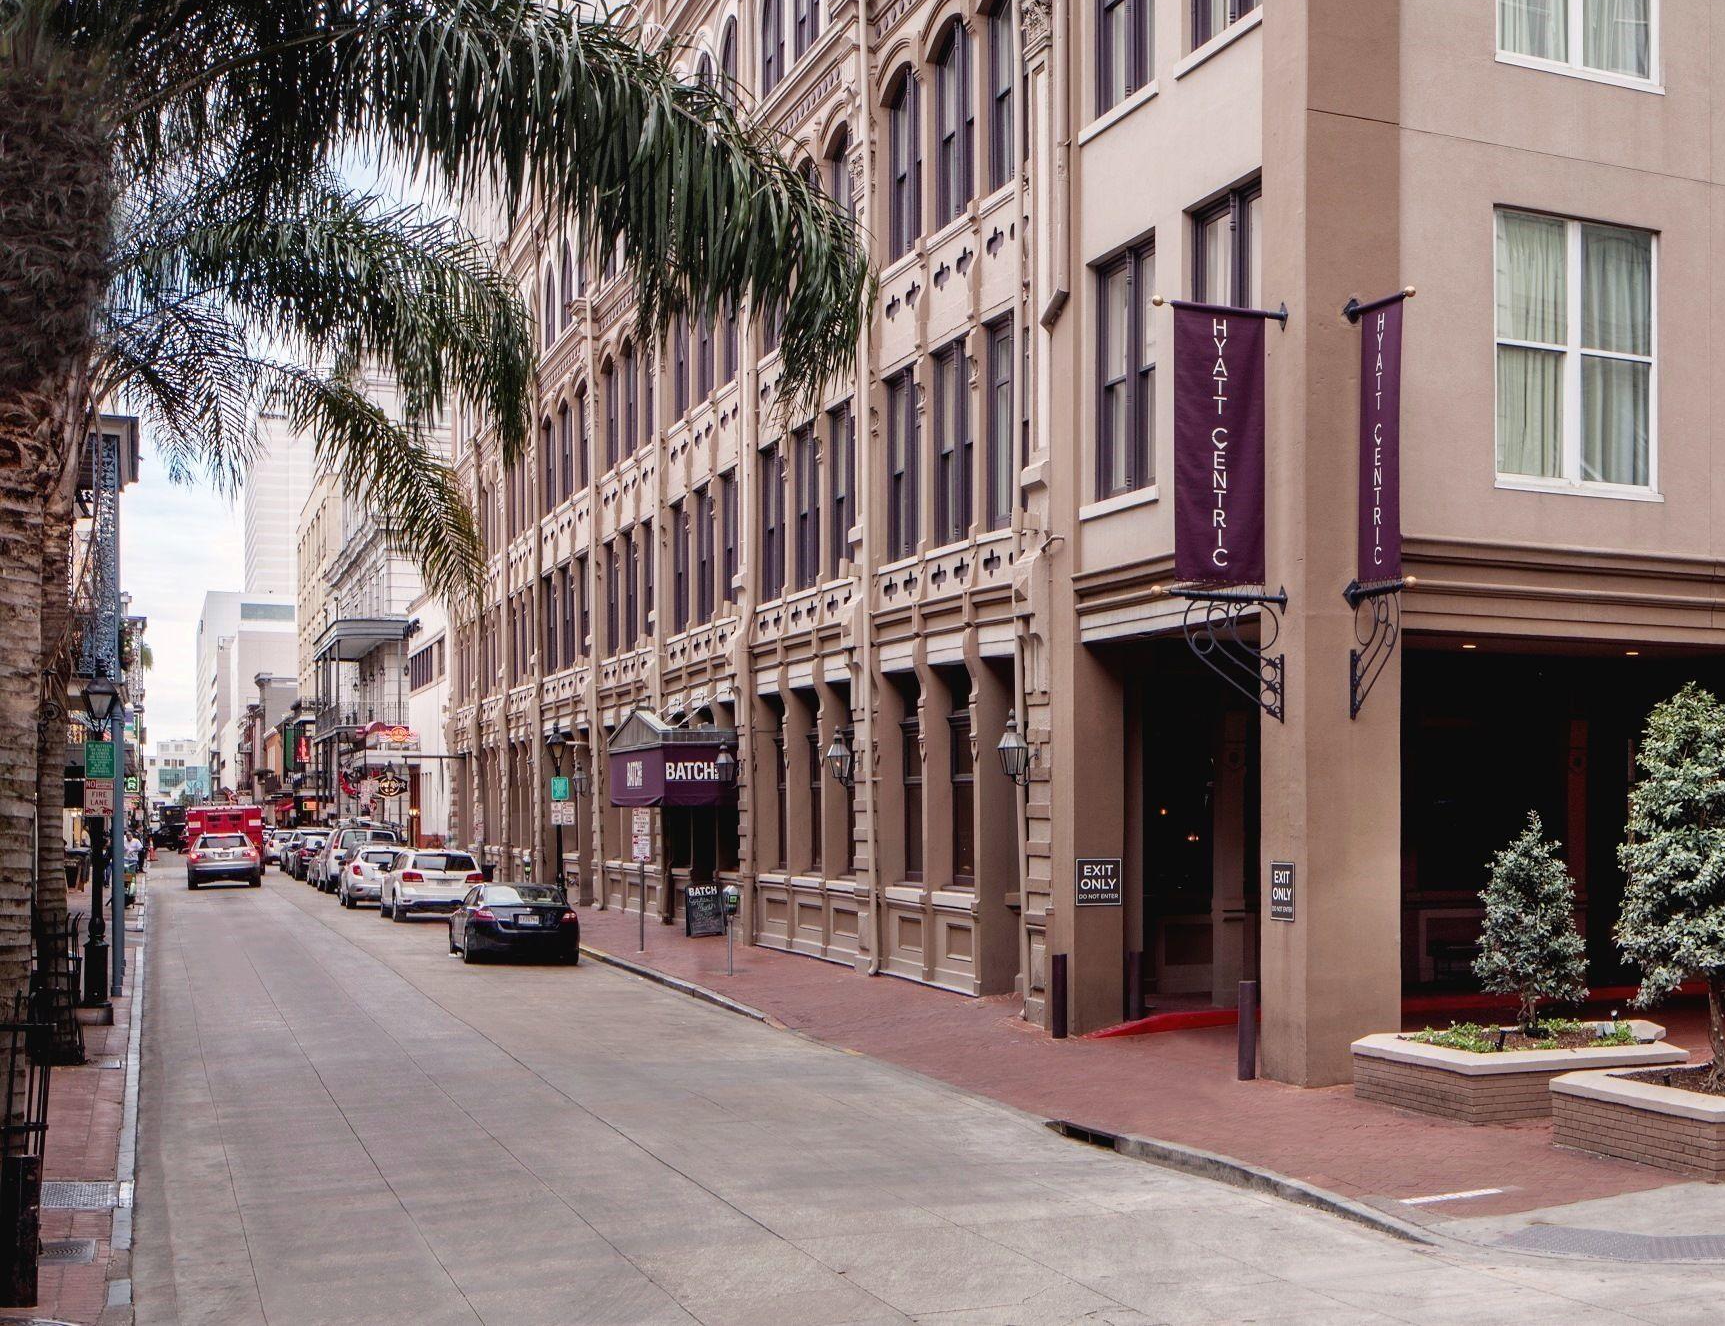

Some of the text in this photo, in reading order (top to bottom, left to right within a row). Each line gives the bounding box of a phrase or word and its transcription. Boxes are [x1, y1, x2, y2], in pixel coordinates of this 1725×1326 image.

[1211, 318, 1229, 567] HYATT CENTRIC
[1374, 313, 1385, 565] HYATT CENTRIC
[665, 761, 714, 780] BATCH
[86, 780, 96, 789] NO
[1083, 864, 1114, 876] EXIT
[1274, 870, 1290, 884] EXIT
[688, 886, 718, 896] BATCH
[1080, 878, 1117, 890] ONLY
[1272, 887, 1292, 901] ONLY
